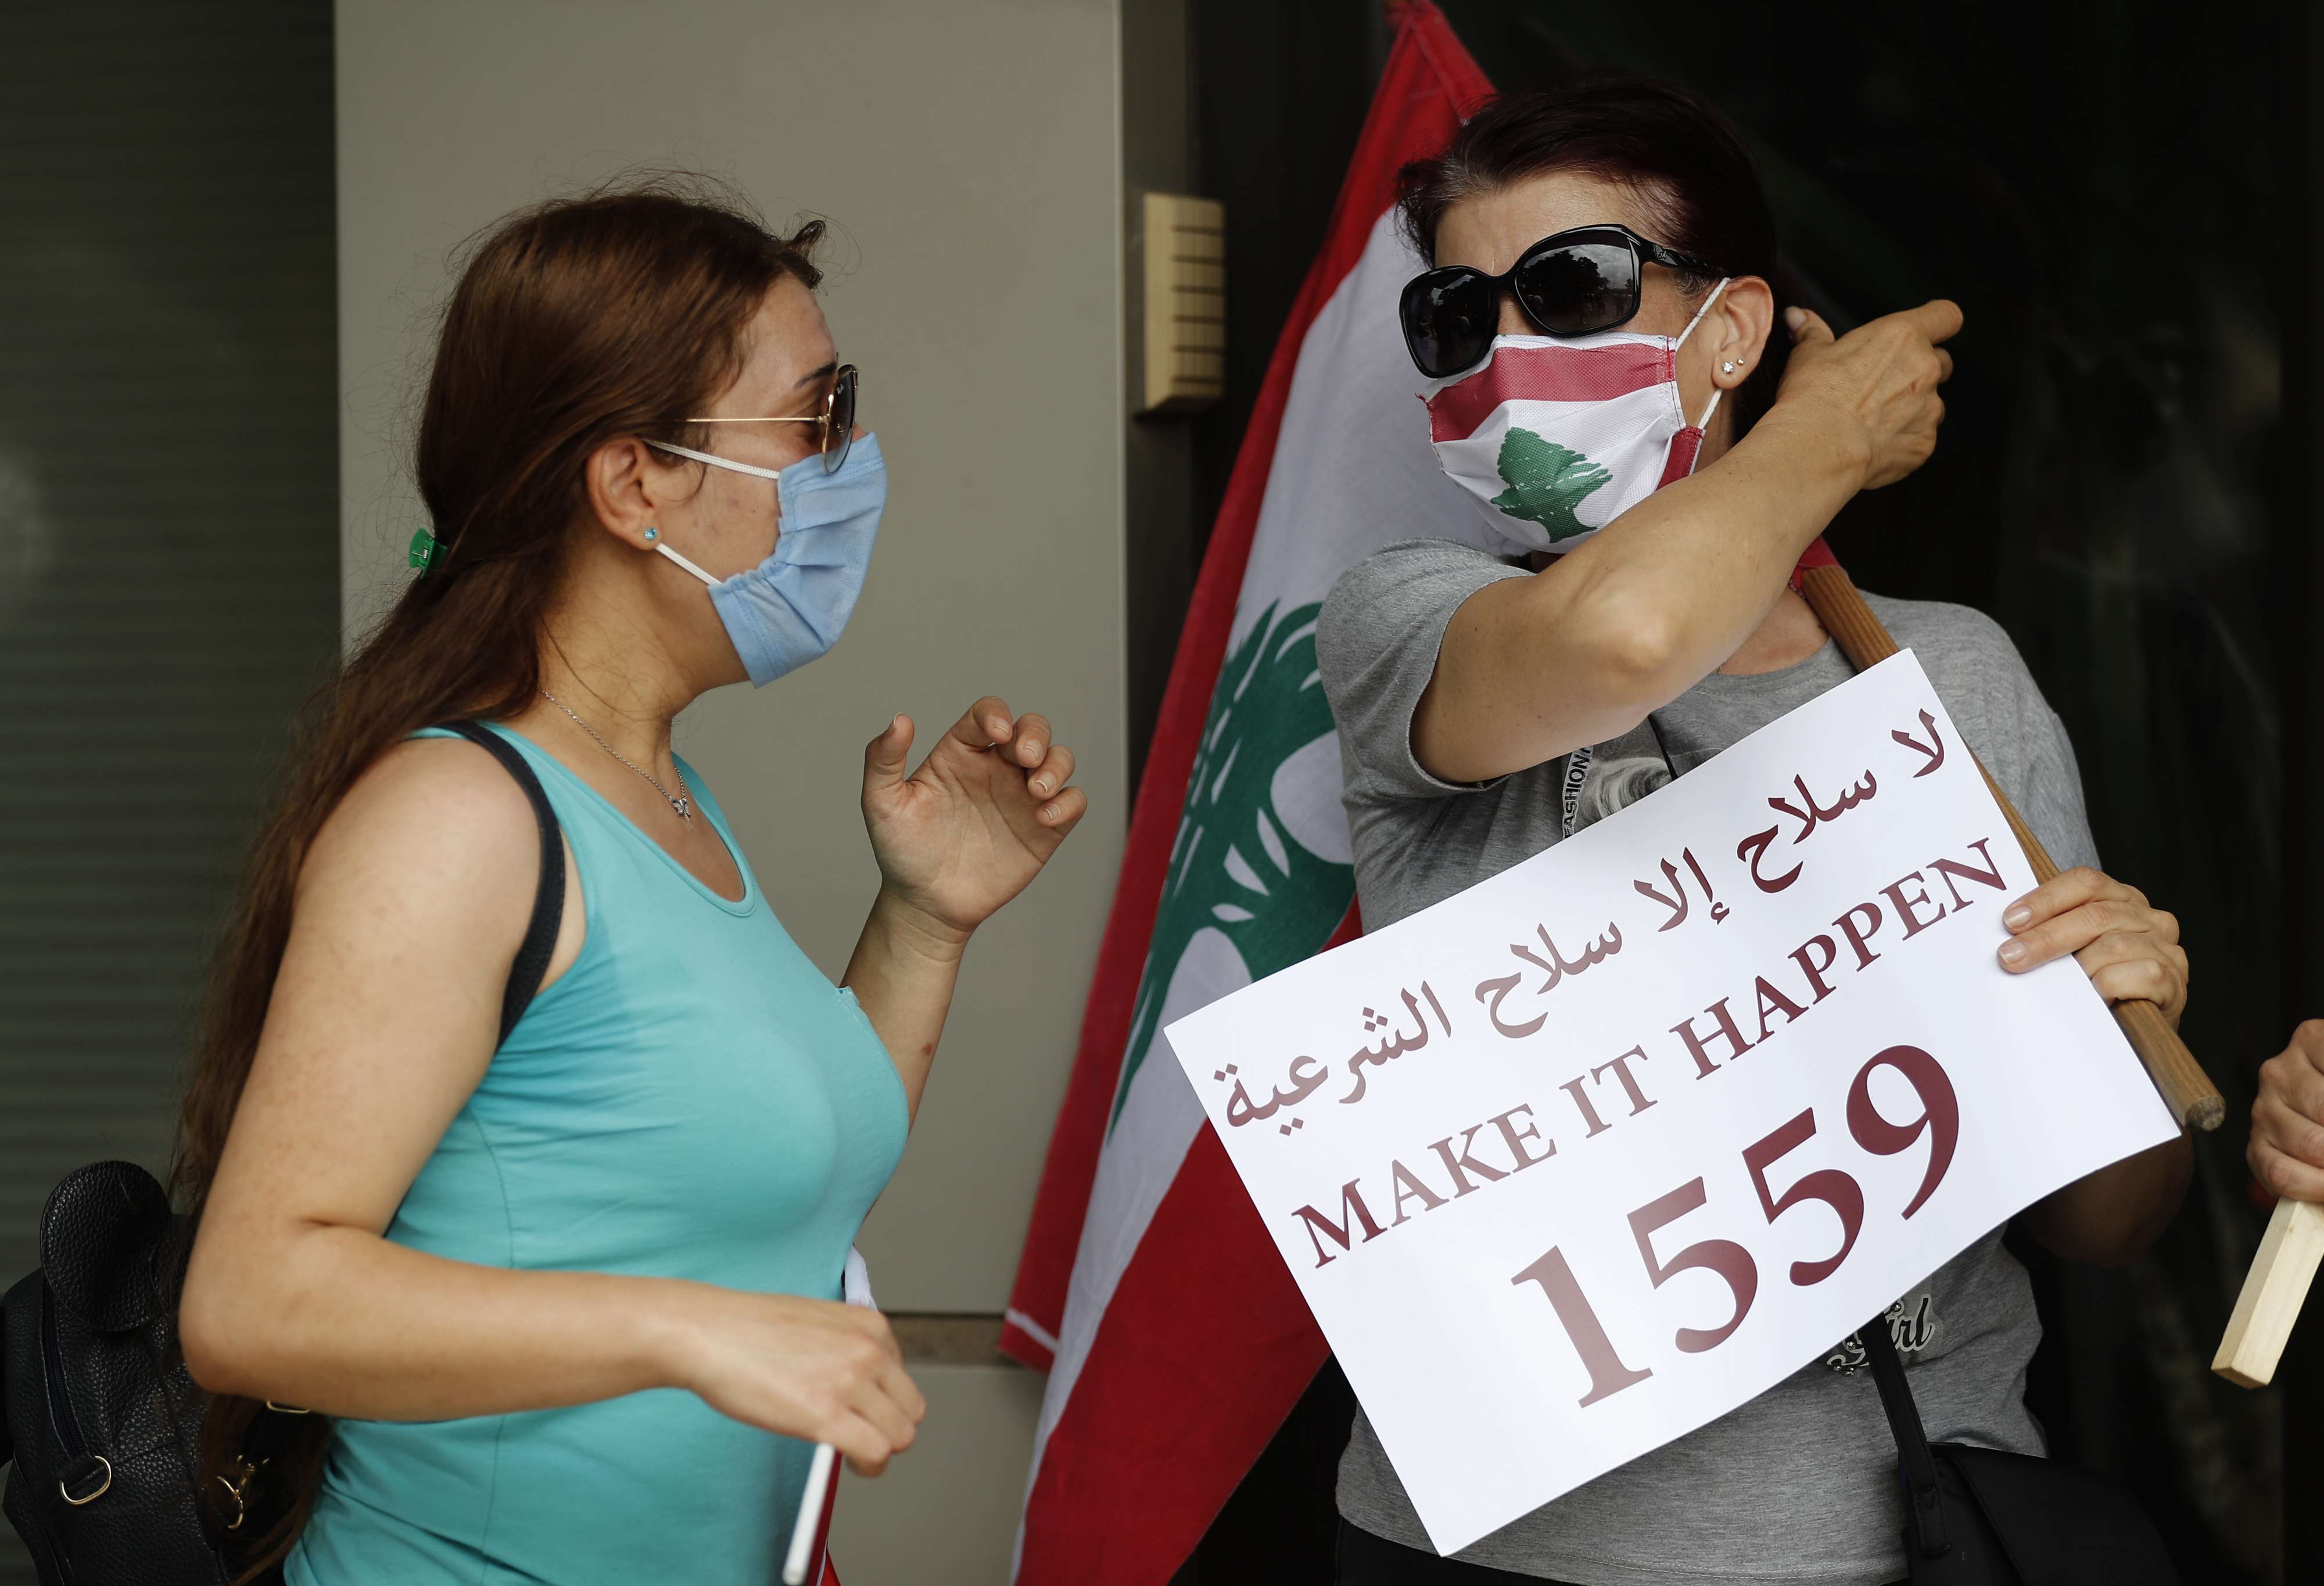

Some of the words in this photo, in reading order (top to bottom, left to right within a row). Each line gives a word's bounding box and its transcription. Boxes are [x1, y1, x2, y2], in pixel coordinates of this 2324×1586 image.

[1891, 708, 1944, 778] لا
[1634, 846, 1730, 932] إلا
[1737, 769, 1877, 893] سلاح
[1475, 921, 1622, 1038] سلاح
[1214, 981, 1451, 1136] الشرعية
[1291, 1103, 1557, 1269] MAKE
[1559, 1045, 1658, 1139] IT
[1669, 837, 2007, 1080] HAPPEN
[1511, 1045, 1959, 1408] 1559
